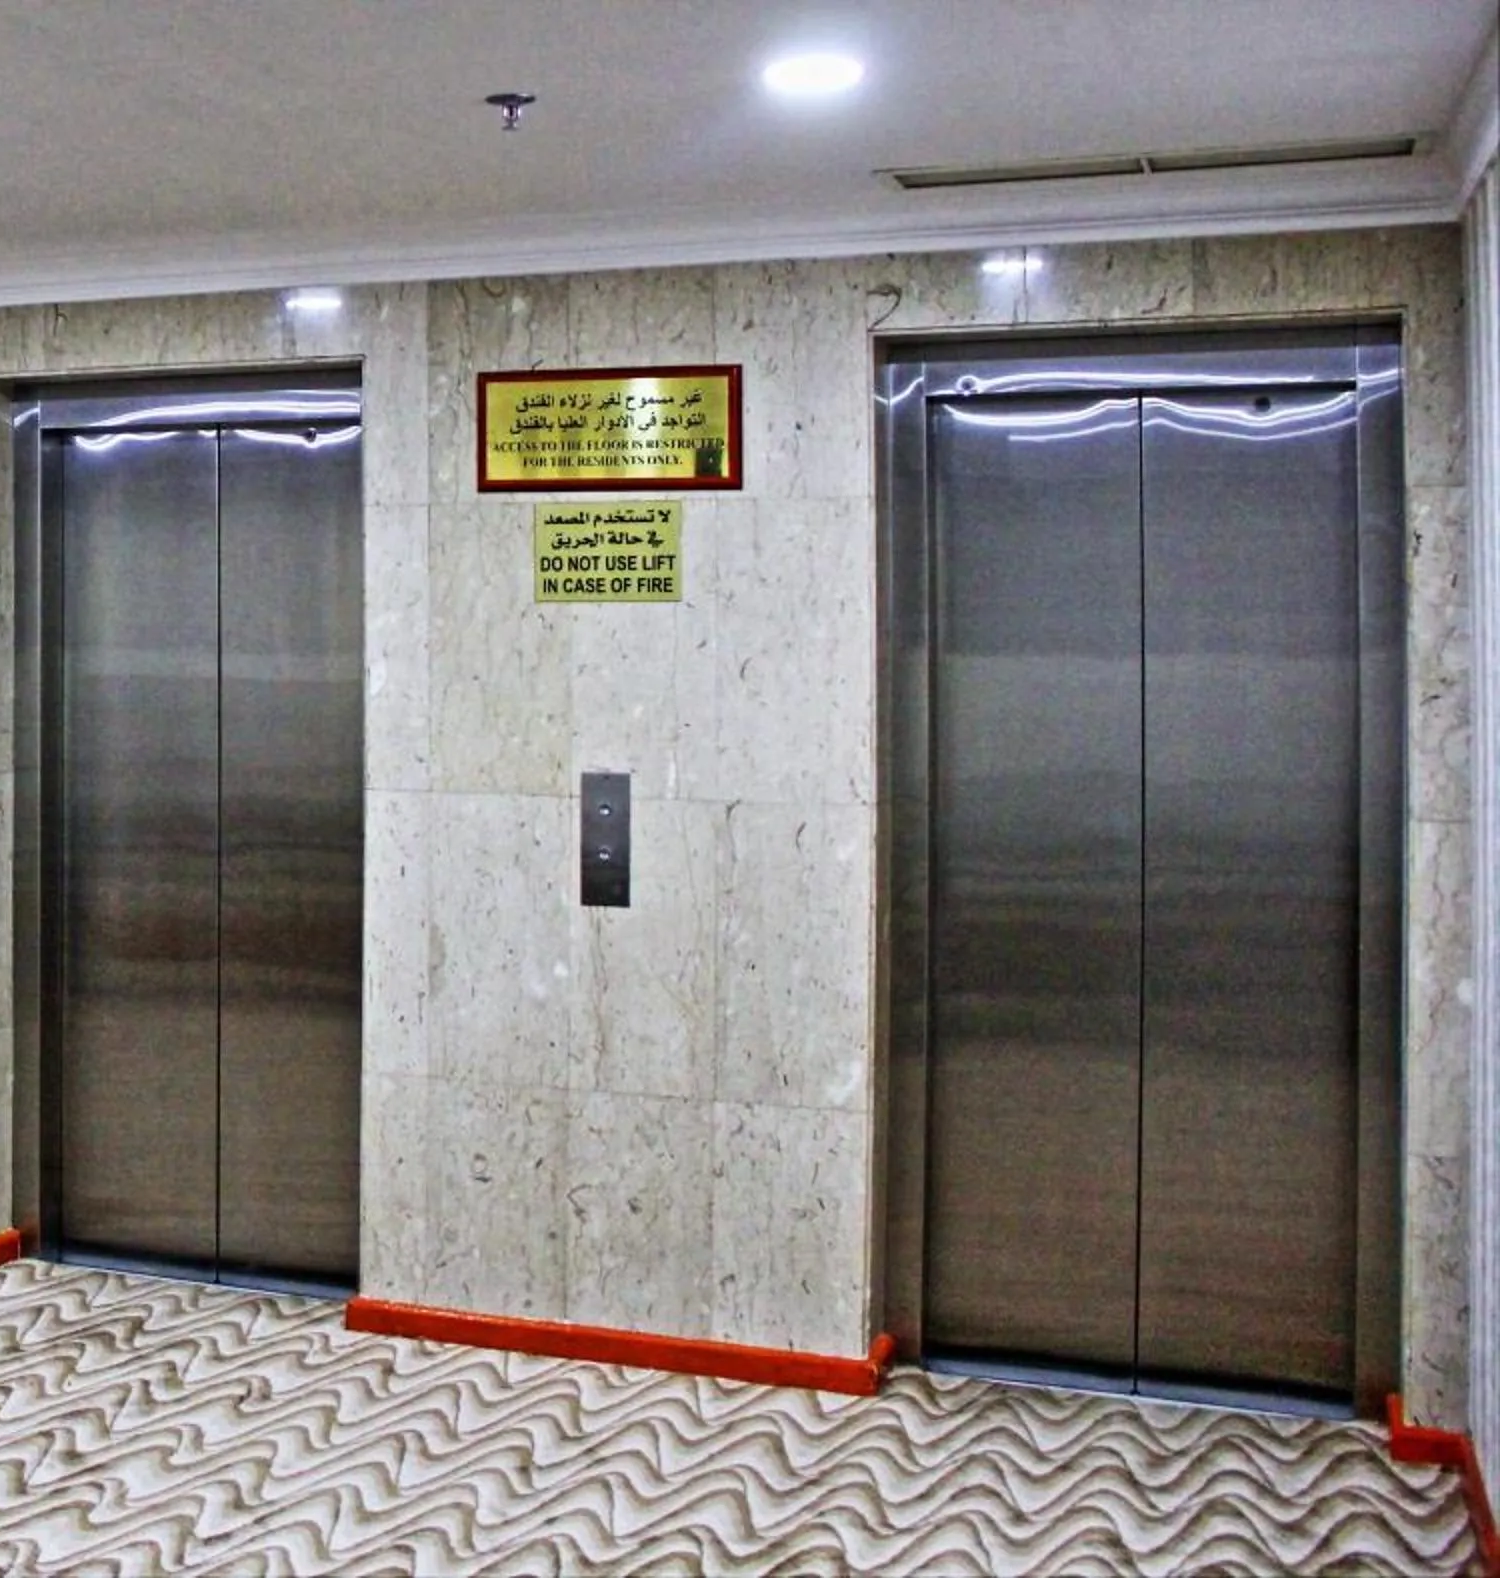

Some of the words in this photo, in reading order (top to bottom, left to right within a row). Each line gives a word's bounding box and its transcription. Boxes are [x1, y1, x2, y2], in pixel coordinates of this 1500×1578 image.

[494, 441, 540, 451] ACCESS
[541, 441, 557, 451] TO
[559, 441, 584, 451] THE
[586, 440, 628, 450] FLOOR
[631, 440, 643, 449] IS
[523, 458, 547, 467] FOR
[549, 458, 575, 467] THE
[577, 456, 645, 467] RESIDENTS
[647, 456, 683, 465] ONLY.
[544, 512, 589, 525] المصعد
[593, 510, 654, 527] تستخدم
[658, 510, 671, 522] لا
[551, 532, 604, 549] الحريق
[608, 531, 644, 544] حالة
[540, 557, 562, 572] DO
[568, 557, 600, 571] NOT
[606, 556, 637, 570] USE
[642, 555, 676, 570] LIFT
[543, 579, 558, 593] IN
[563, 578, 606, 593] CASE
[610, 578, 632, 592] OF
[637, 578, 673, 592] FIRE
